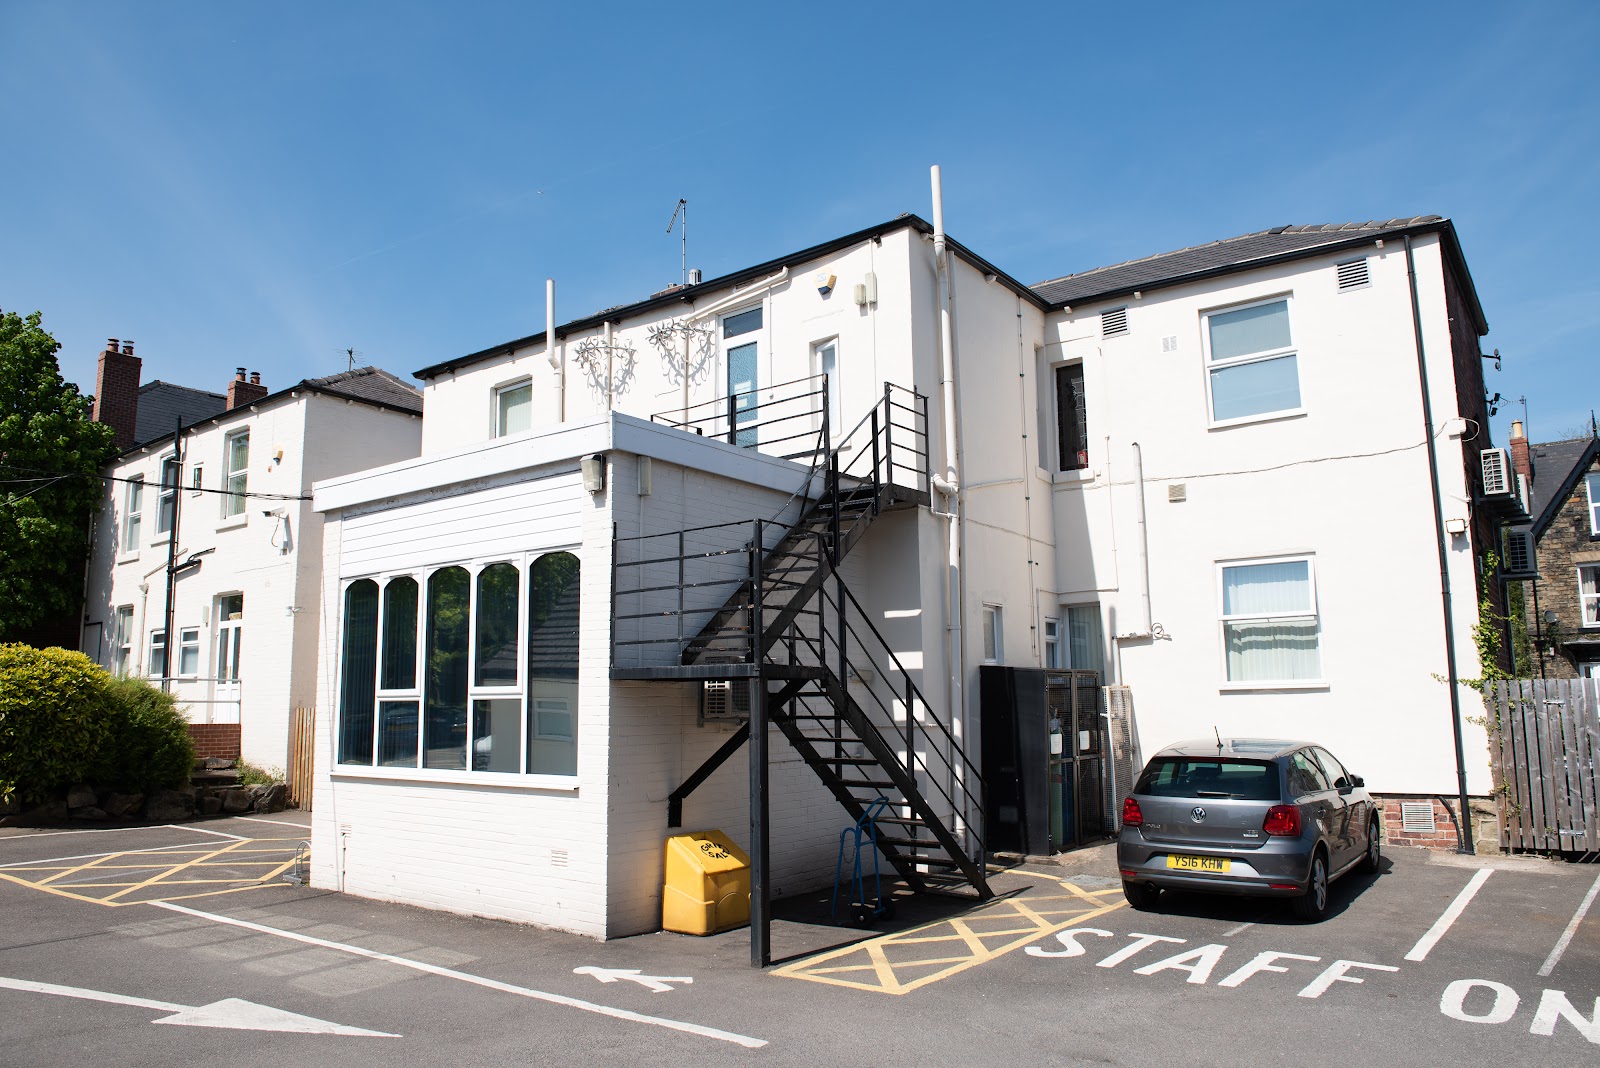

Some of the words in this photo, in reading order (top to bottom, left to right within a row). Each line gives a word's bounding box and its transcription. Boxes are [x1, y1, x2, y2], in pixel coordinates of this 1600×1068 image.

[708, 849, 730, 859] SALT
[1174, 856, 1198, 867] YS16
[1201, 858, 1224, 869] KHW
[1025, 928, 1400, 998] STAFF
